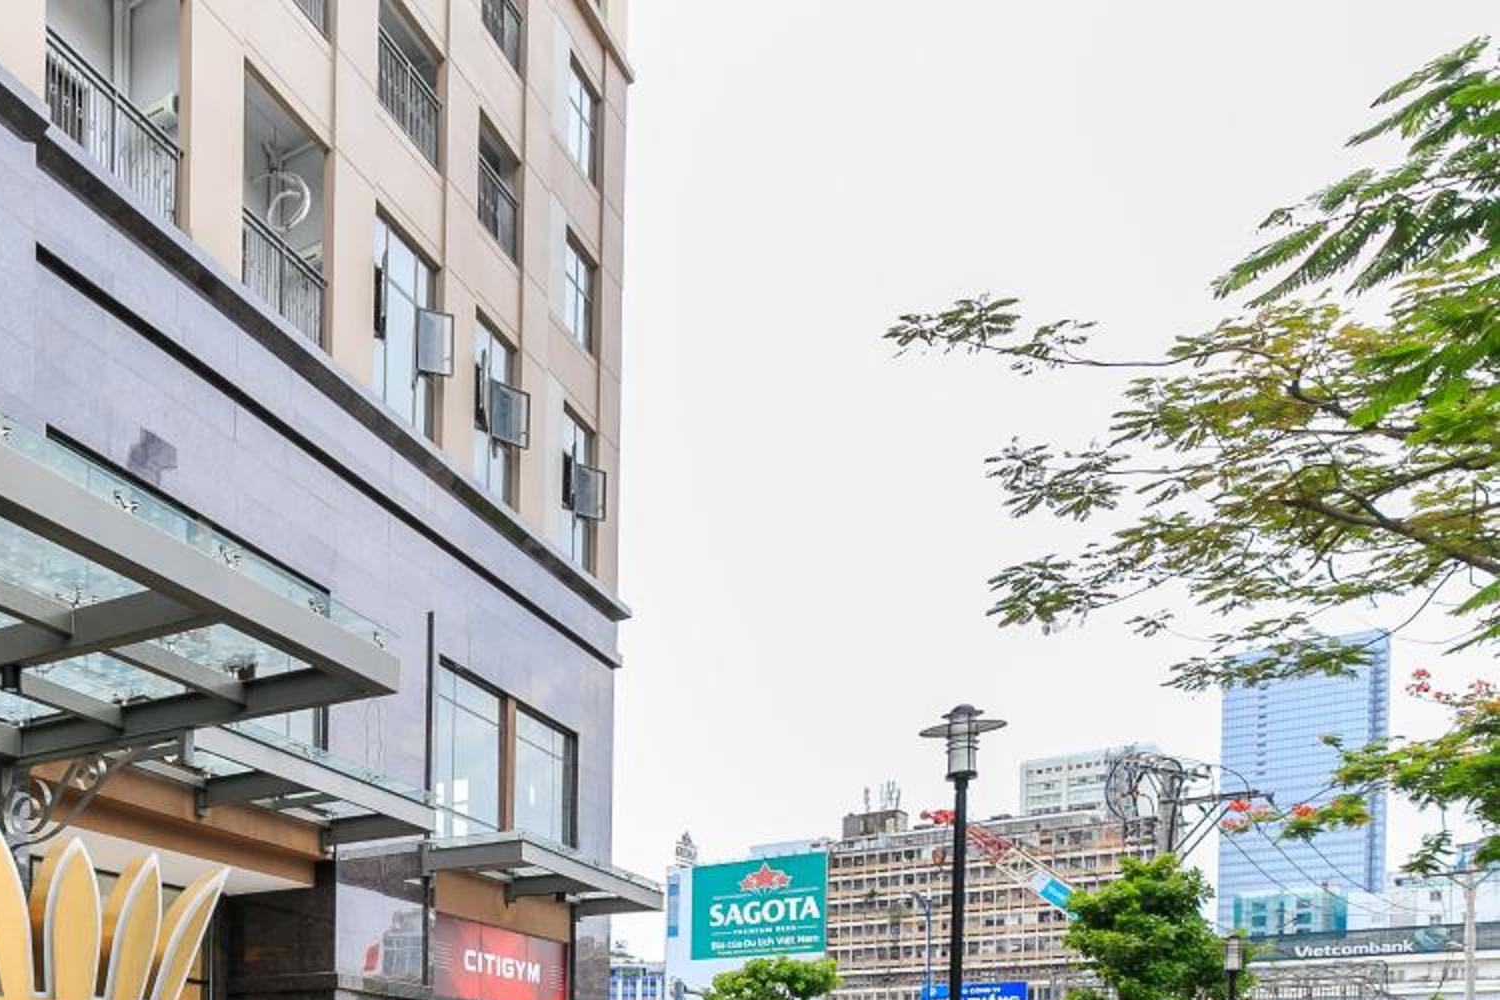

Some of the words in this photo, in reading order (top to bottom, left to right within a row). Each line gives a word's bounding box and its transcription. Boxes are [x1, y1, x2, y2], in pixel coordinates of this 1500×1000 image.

[709, 896, 820, 927] SAGOTA
[1294, 939, 1414, 958] Vietcombank
[464, 949, 541, 984] CITIGYM
